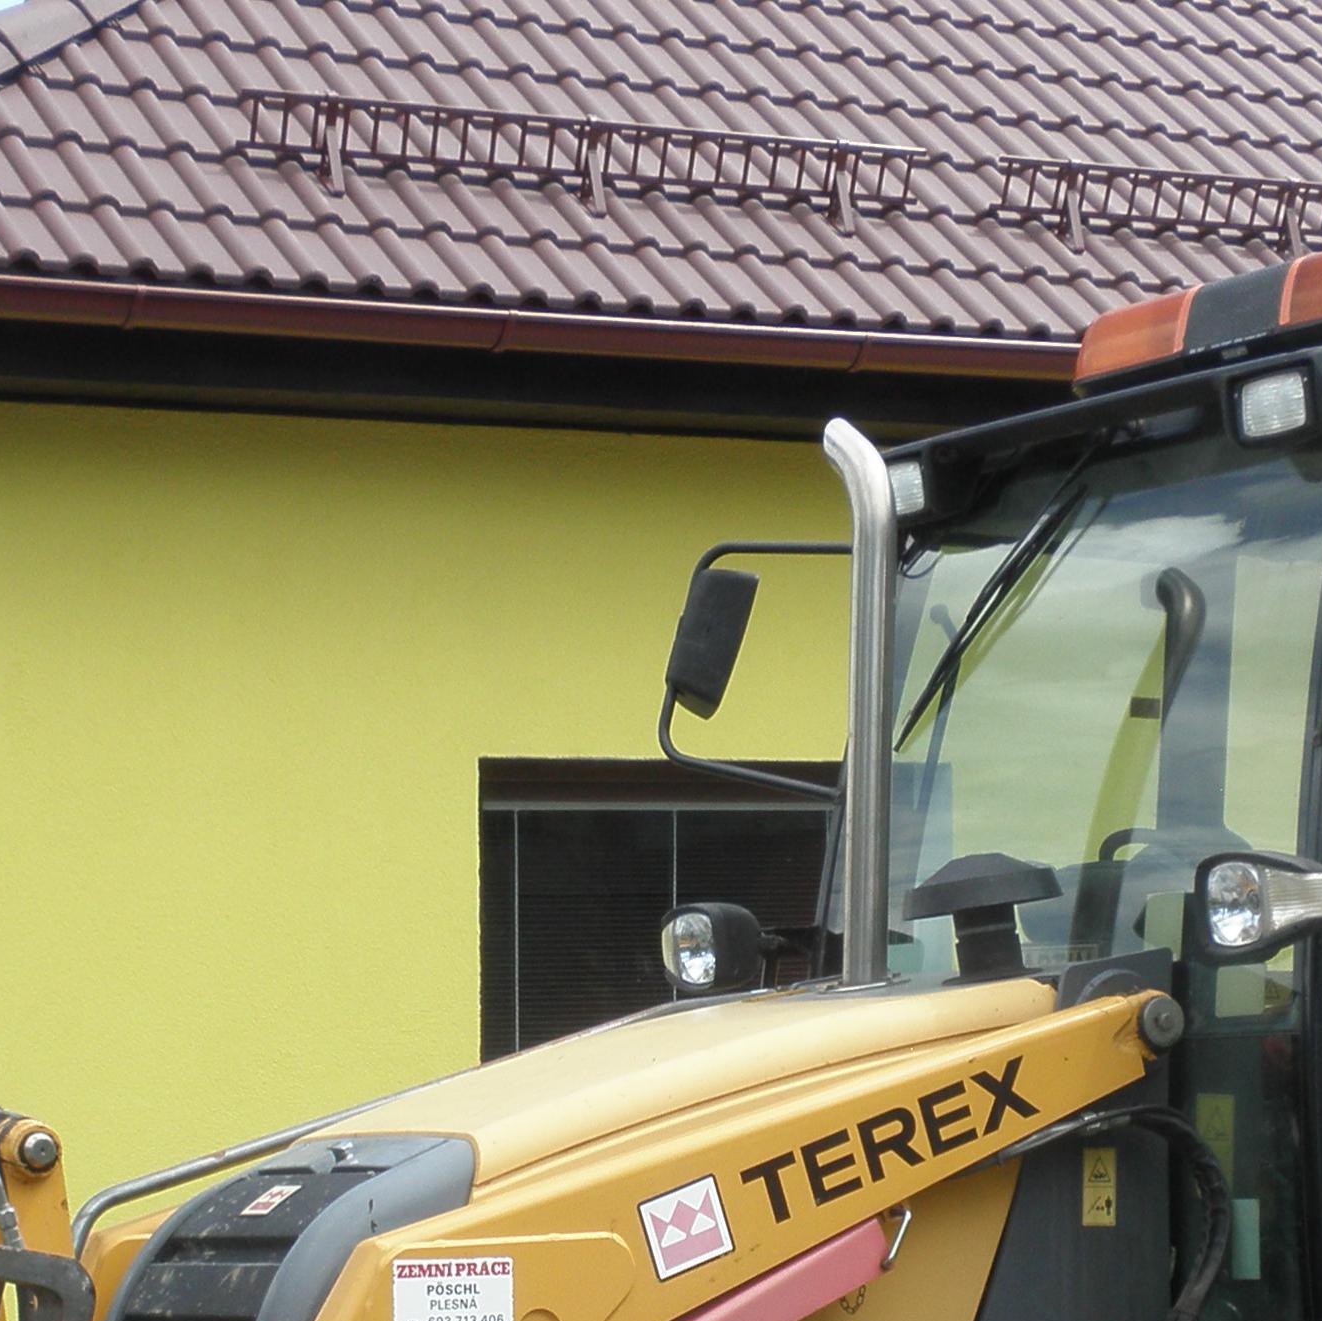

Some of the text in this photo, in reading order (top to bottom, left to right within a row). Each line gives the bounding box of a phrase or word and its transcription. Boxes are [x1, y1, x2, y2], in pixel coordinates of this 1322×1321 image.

[740, 1055, 1041, 1224] TEREX
[397, 1261, 510, 1278] ZEMNÍ PRÁCE
[427, 1281, 480, 1296] PÖSCHL
[429, 1296, 478, 1310] PLESNÁ
